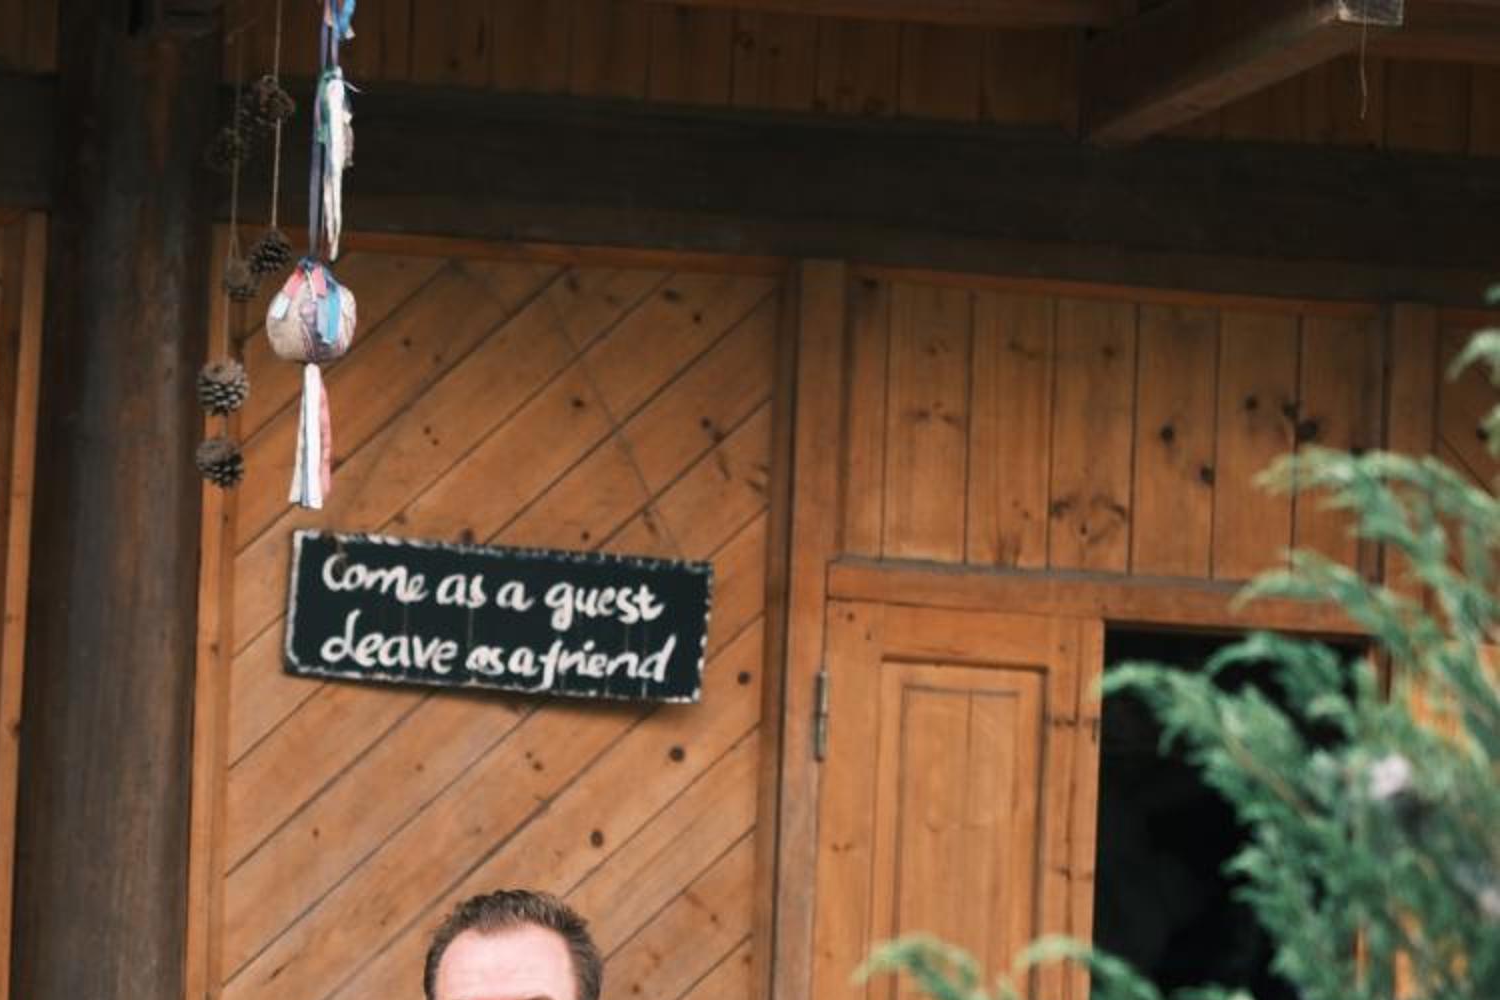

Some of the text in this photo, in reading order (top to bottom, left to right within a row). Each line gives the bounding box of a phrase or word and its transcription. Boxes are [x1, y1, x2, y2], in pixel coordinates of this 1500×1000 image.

[322, 552, 665, 631] Come as a guest
[539, 634, 676, 691] friend
